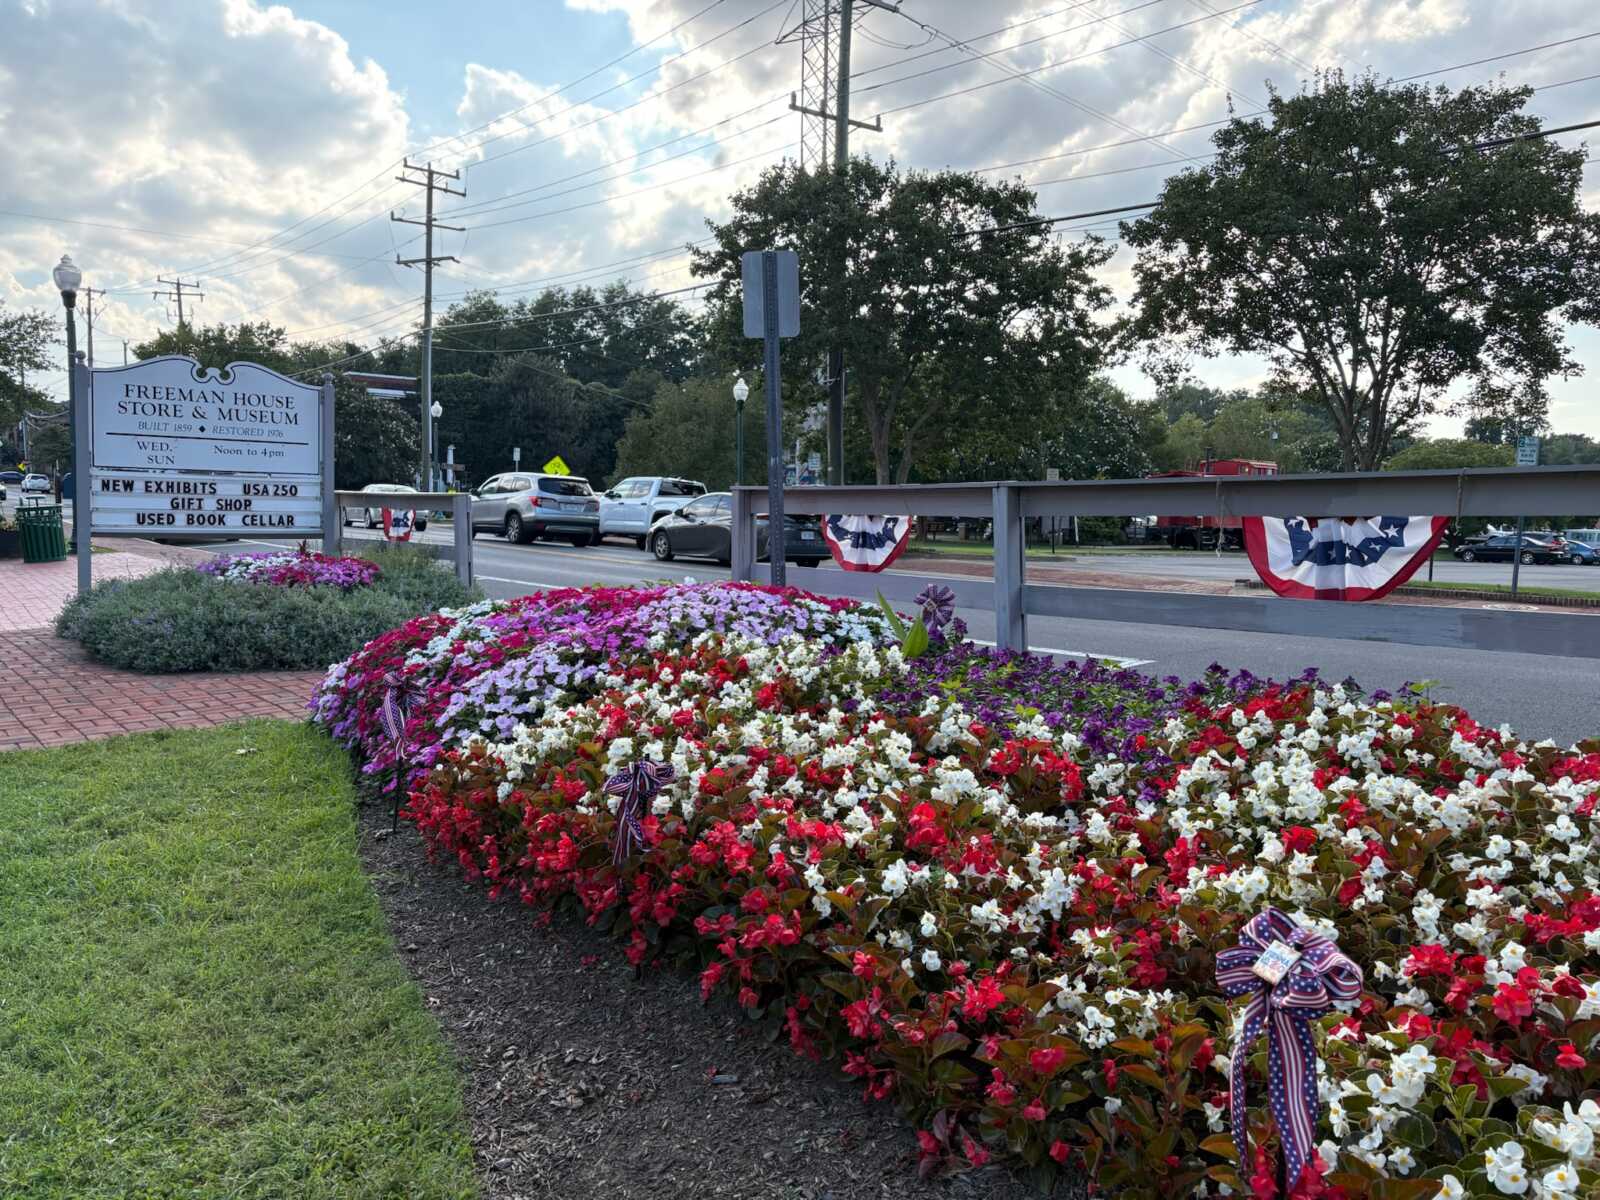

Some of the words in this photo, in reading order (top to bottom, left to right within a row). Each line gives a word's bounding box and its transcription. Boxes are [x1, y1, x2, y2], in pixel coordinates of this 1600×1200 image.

[124, 383, 224, 404] FREEMAN
[233, 392, 295, 409] HOUSE
[117, 400, 184, 418] STORE
[191, 405, 208, 420] &
[217, 407, 298, 425] MUSEUM
[138, 421, 170, 432] BUILT
[174, 423, 193, 433] 1859
[212, 425, 265, 437] RESTORED
[213, 445, 242, 456] Noon
[247, 448, 258, 456] to
[147, 455, 175, 465] SUN
[101, 479, 135, 492] NEW
[144, 480, 217, 495] EXHIBITS
[170, 497, 204, 511] GIFT
[215, 498, 252, 511] SHOP
[136, 512, 176, 526] USED
[186, 513, 226, 526] BOOK
[241, 514, 295, 527] CELLAR
